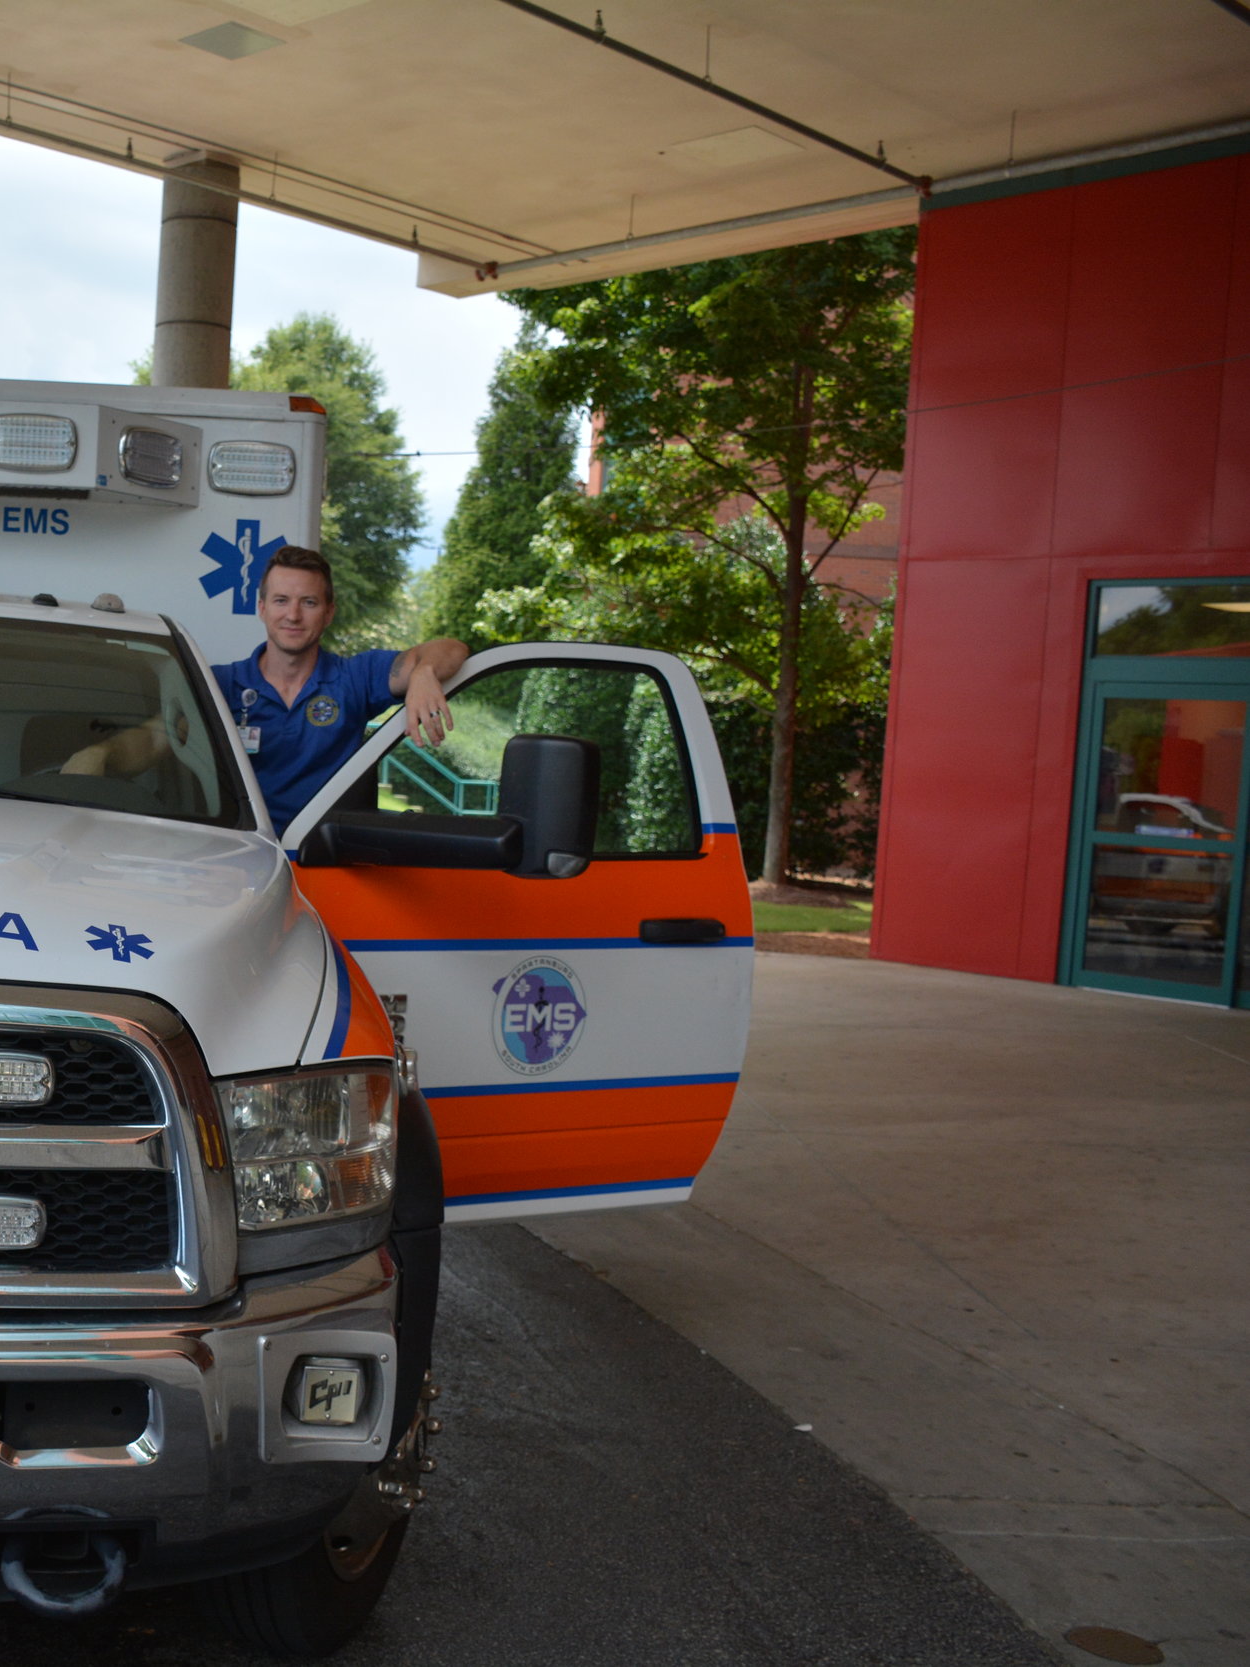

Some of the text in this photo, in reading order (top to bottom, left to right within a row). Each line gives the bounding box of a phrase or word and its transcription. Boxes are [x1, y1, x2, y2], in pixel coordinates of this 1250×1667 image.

[2, 506, 70, 536] EMS
[510, 958, 574, 981] SPARTANBURG
[503, 1002, 577, 1033] EMS
